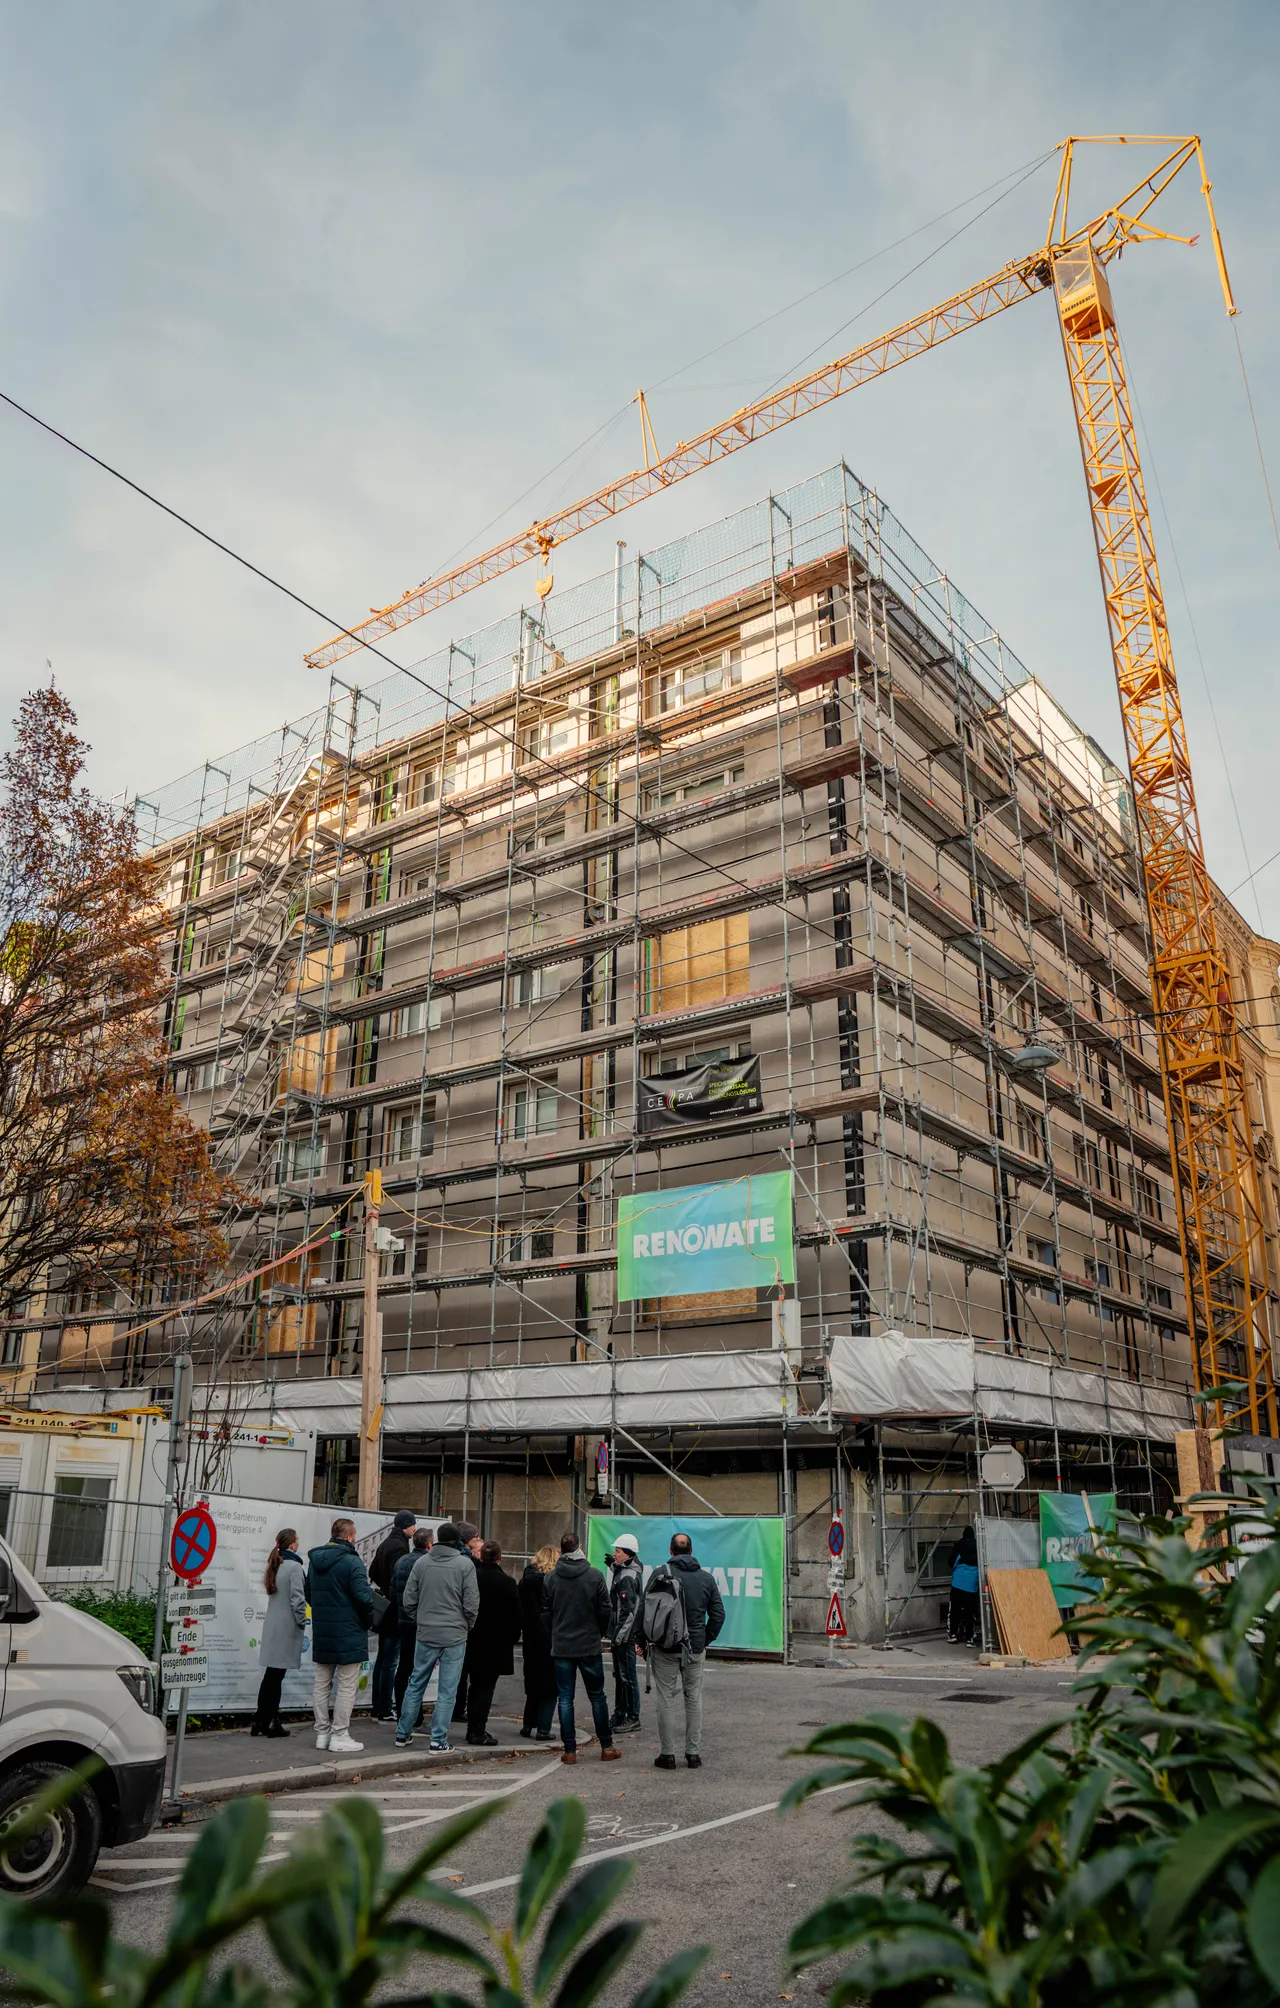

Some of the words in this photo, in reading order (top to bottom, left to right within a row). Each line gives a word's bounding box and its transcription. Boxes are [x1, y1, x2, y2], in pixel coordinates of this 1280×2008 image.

[633, 1216, 776, 1259] RENOWATE
[233, 1512, 267, 1524] Sanierung
[170, 1591, 179, 1602] gilt
[180, 1591, 187, 1600] ab
[168, 1609, 178, 1617] von
[190, 1604, 199, 1615] bis
[177, 1631, 197, 1642] Ende
[162, 1656, 207, 1669] ausgenommen
[163, 1672, 206, 1684] Baufahrzeuge
